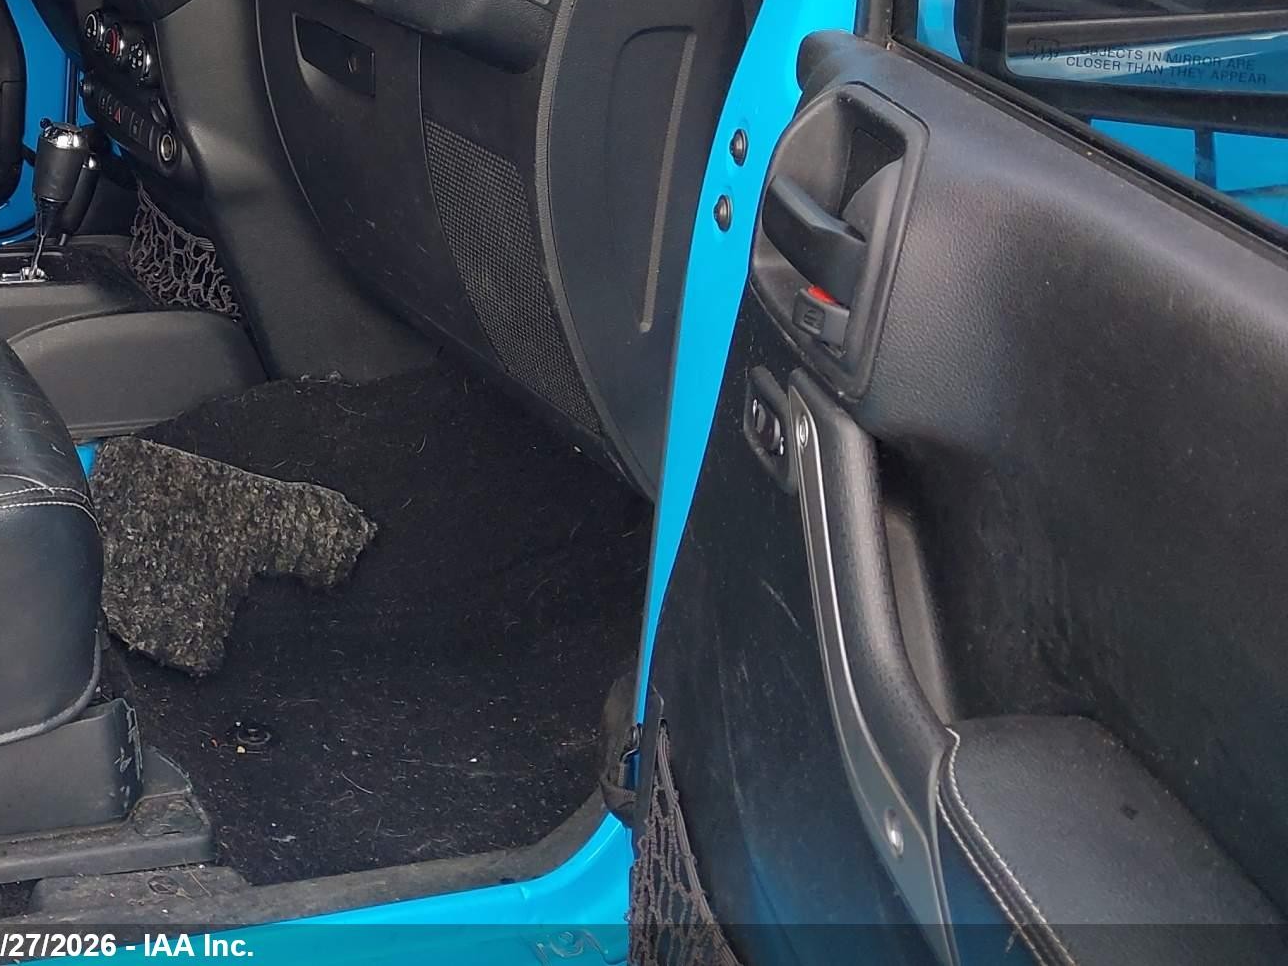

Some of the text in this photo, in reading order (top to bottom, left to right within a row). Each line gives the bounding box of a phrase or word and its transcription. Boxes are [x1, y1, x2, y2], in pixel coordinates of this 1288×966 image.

[1066, 56, 1267, 84] CLOSER THAN THEY APPEAR
[1079, 44, 1143, 60] OBJECTS
[1147, 50, 1162, 62] IN
[1166, 53, 1221, 67] MIRROR
[1227, 56, 1257, 71] ARE
